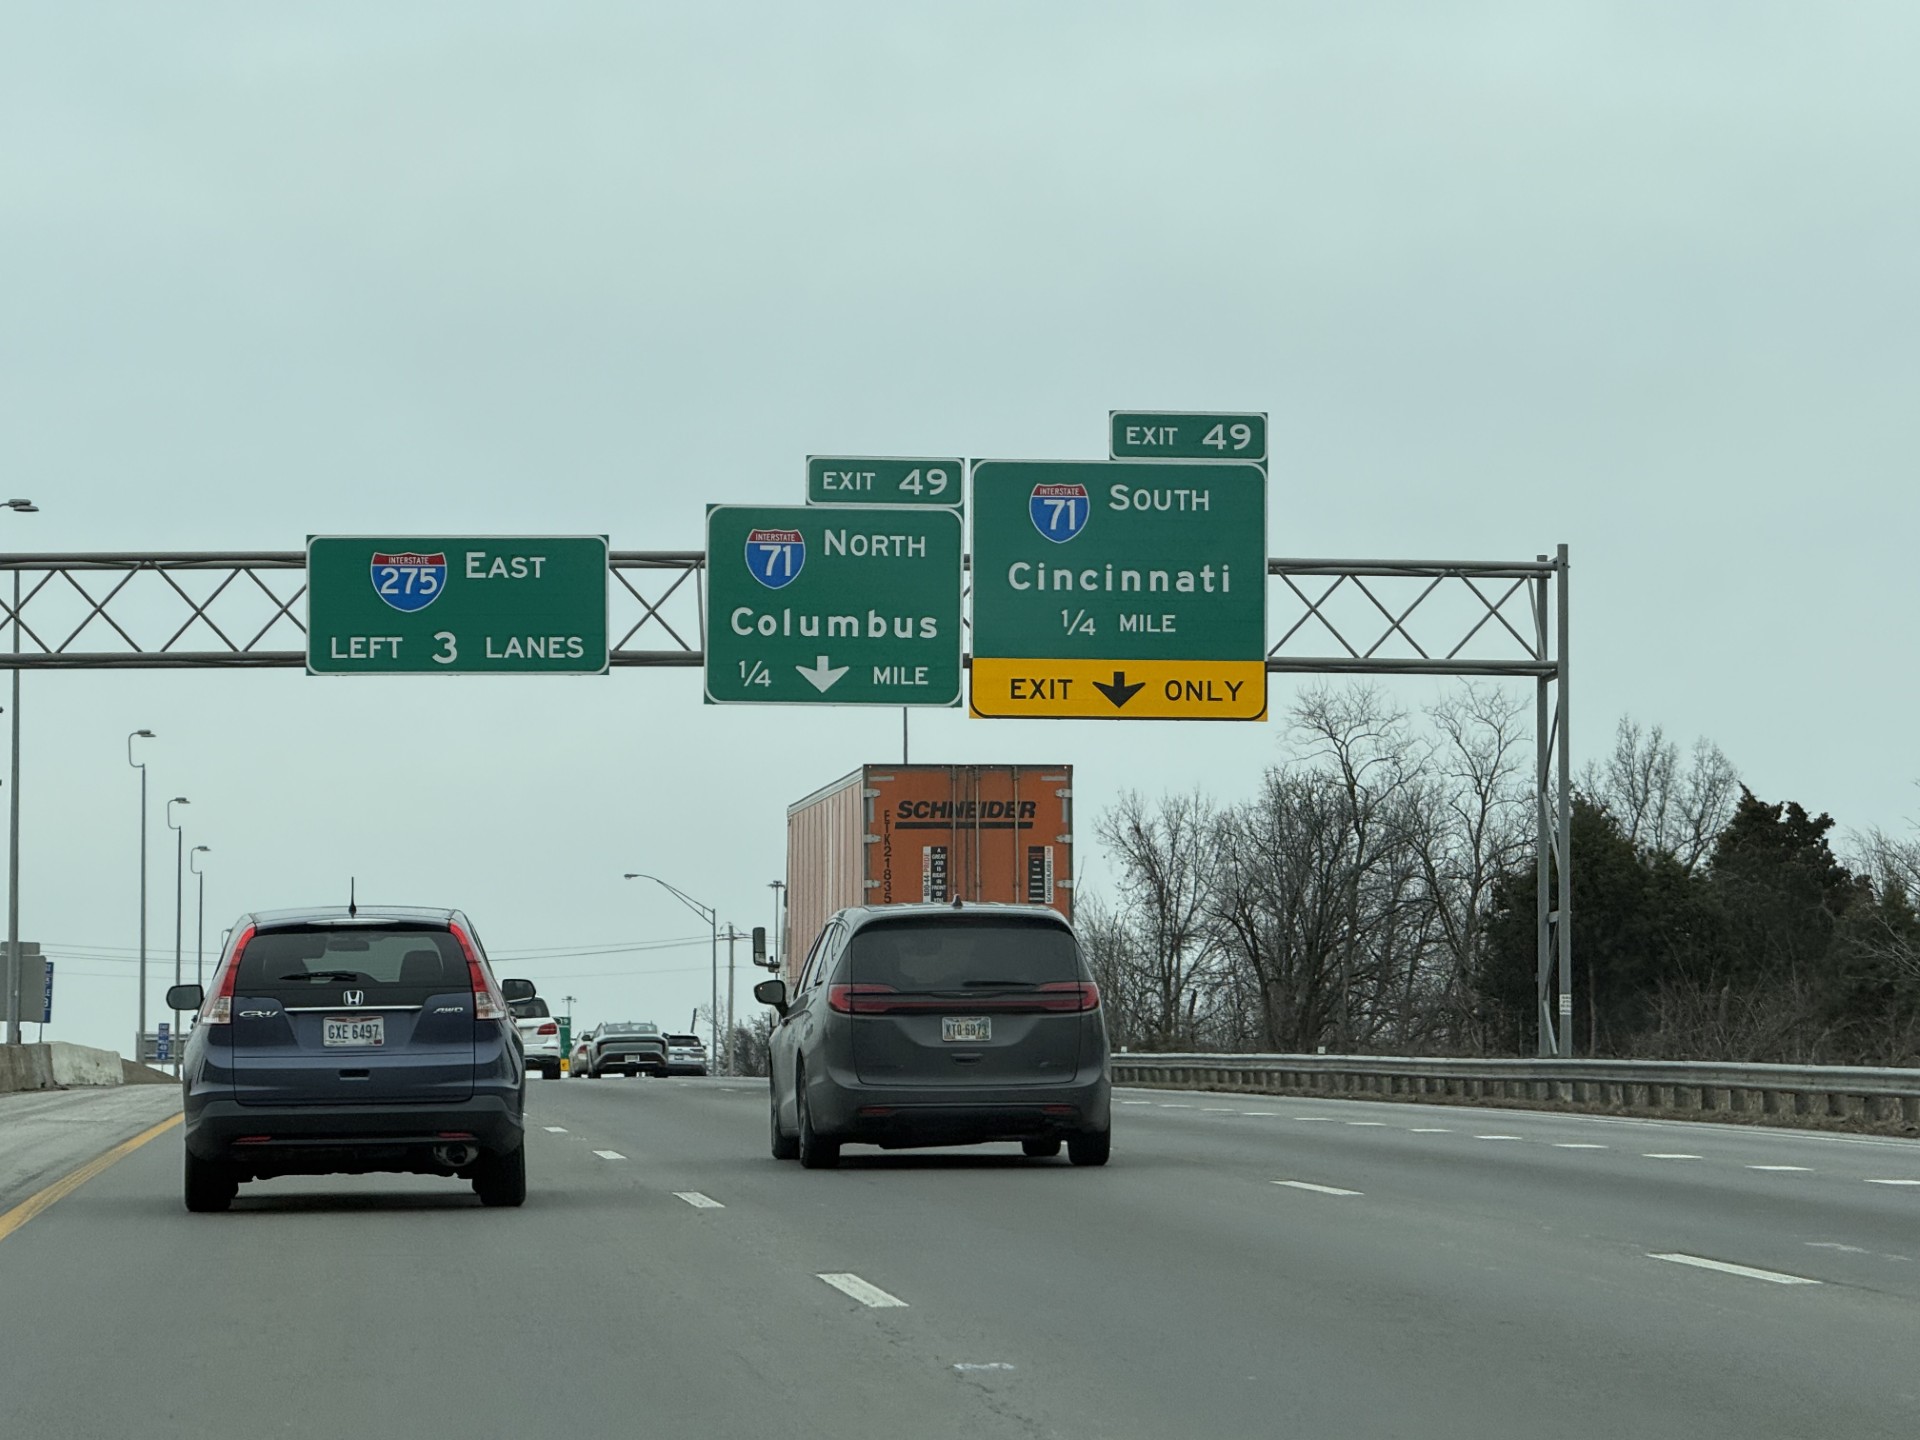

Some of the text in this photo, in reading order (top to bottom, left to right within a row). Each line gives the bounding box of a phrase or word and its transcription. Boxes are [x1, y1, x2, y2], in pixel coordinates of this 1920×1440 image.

[1126, 423, 1251, 450] EXIT 49
[823, 468, 948, 495] EXIT 49
[1039, 487, 1080, 496] INTERSTATE
[1043, 484, 1209, 531] 71 SOUTH
[755, 533, 796, 542] INTERSTATE
[388, 556, 430, 565] INTERSTATE
[759, 529, 926, 577] 71 NORTH
[380, 551, 546, 595] 275 EAST
[1008, 561, 1230, 593] Cincinnati
[731, 606, 938, 639] Columbus
[1061, 609, 1176, 636] 1/4 MILE
[331, 631, 584, 664] LEFT 3 LANES
[738, 660, 929, 687] 1/4 MILE
[1010, 678, 1244, 702] EXIT ONLY
[896, 799, 1037, 820] SCHNEIDER
[432, 1006, 464, 1014] AWD
[328, 1024, 379, 1039] GXE 6497
